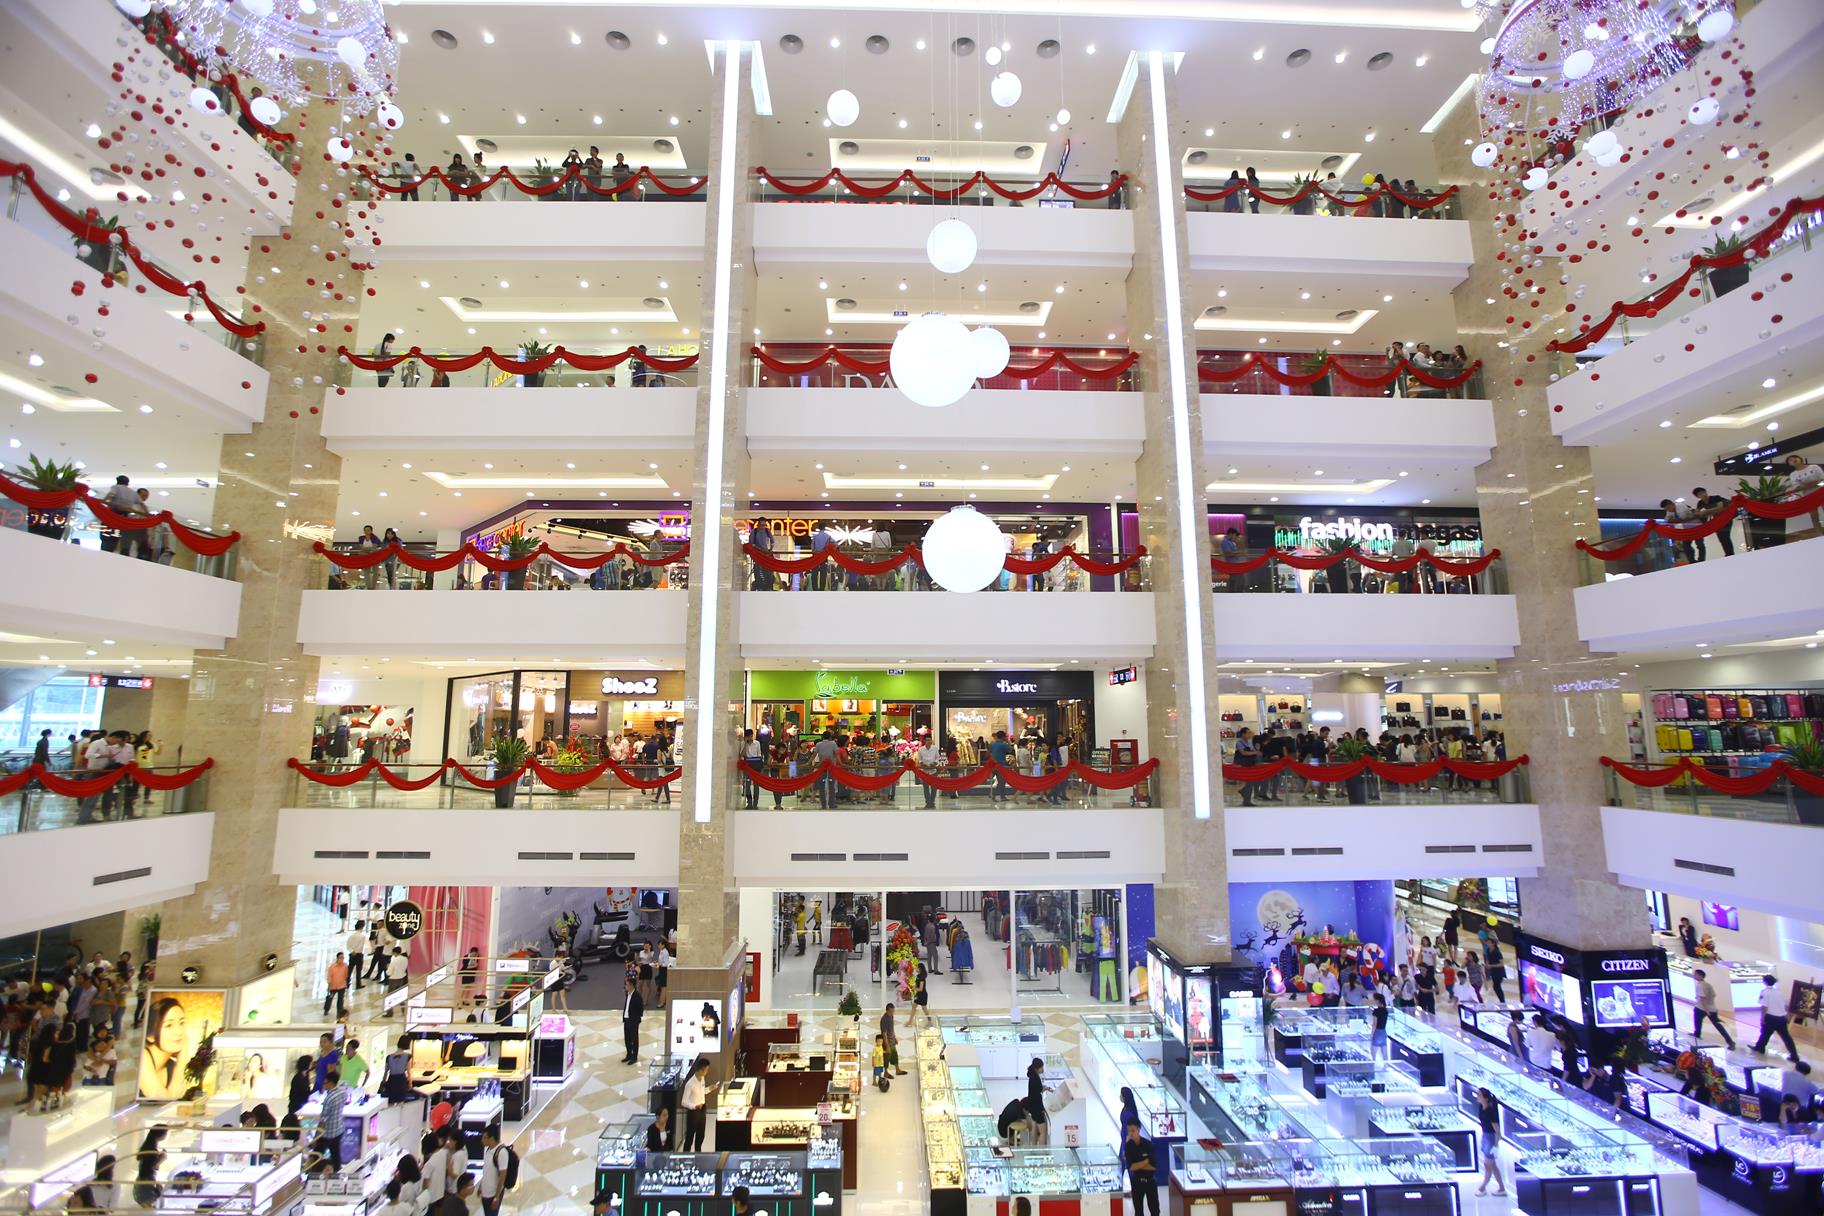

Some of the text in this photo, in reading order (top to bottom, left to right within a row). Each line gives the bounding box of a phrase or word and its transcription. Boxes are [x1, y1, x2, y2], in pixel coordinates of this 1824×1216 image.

[1299, 517, 1394, 541] fashion
[389, 911, 421, 931] beauty
[1530, 945, 1565, 965] SEIKO
[1601, 959, 1649, 972] CITIZEN
